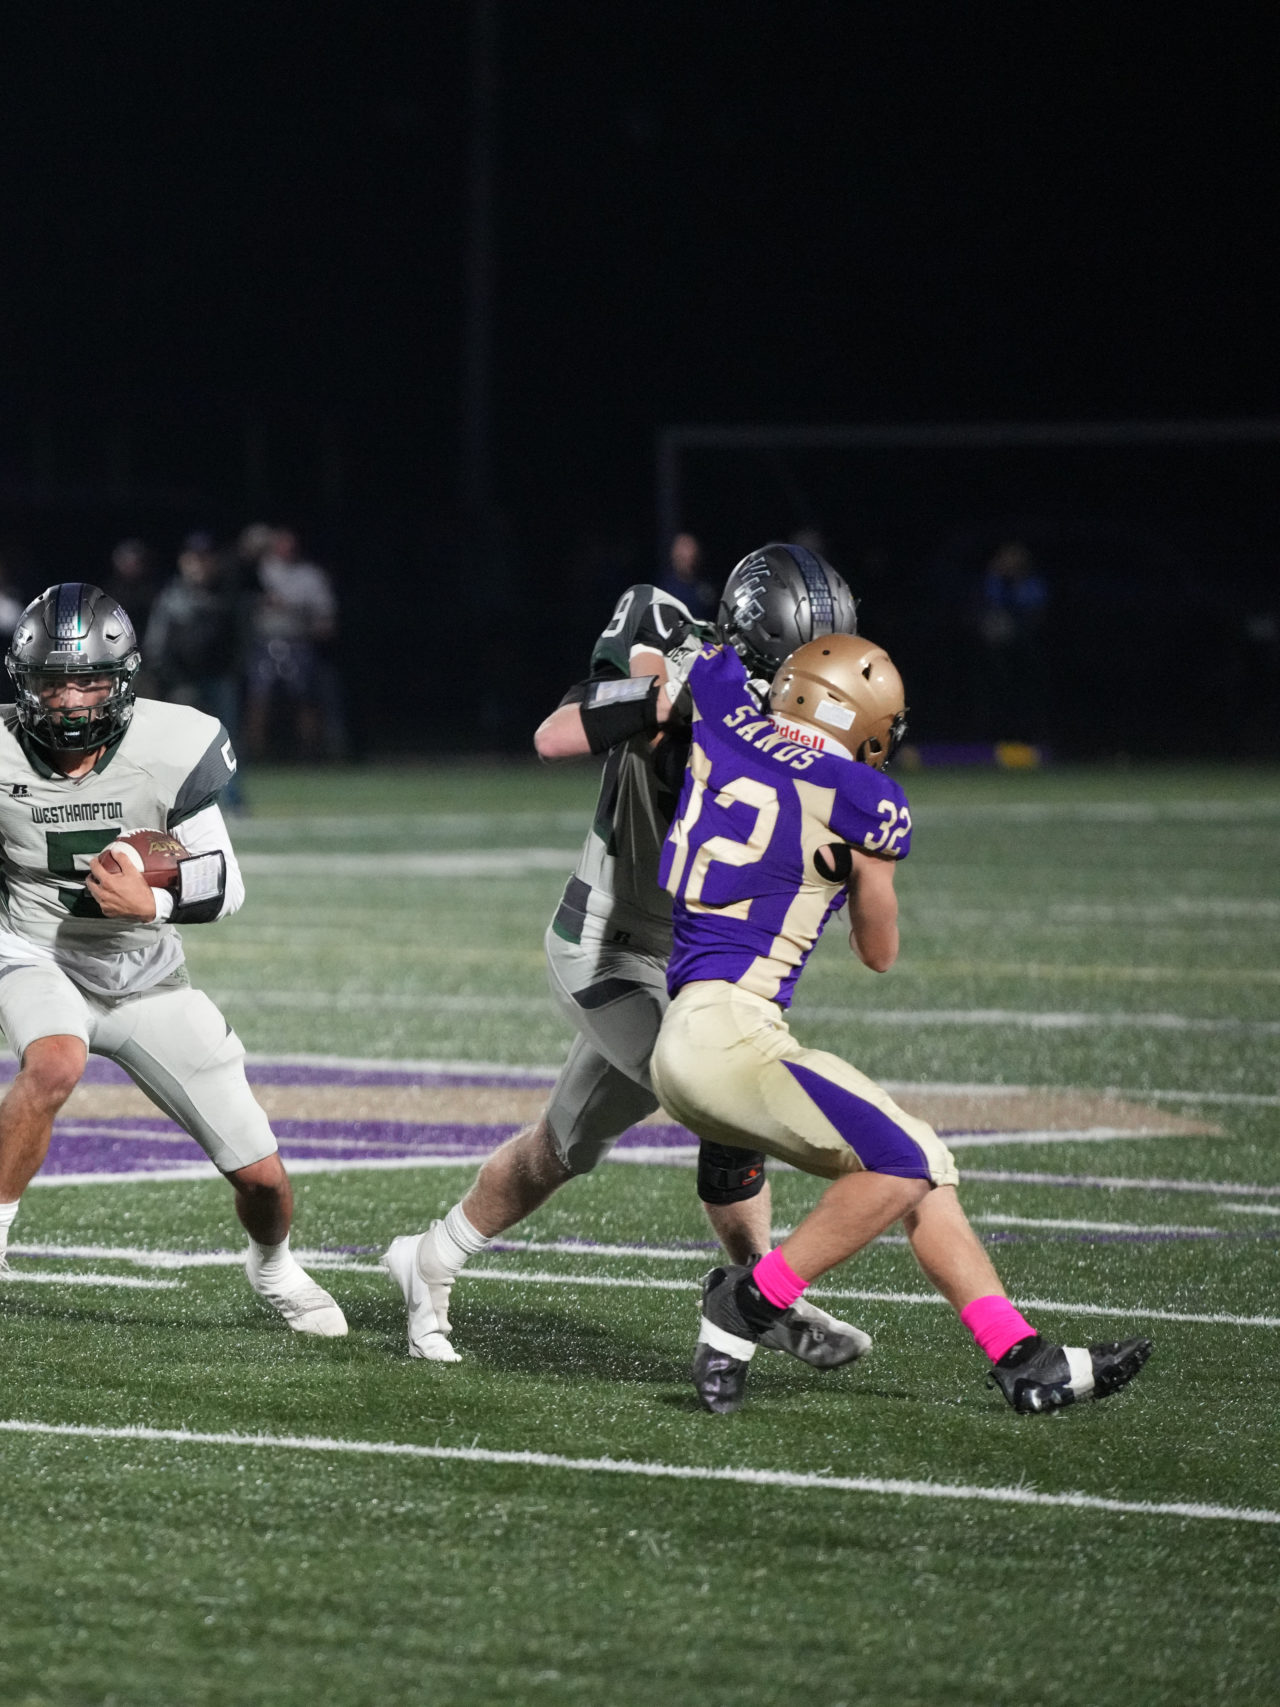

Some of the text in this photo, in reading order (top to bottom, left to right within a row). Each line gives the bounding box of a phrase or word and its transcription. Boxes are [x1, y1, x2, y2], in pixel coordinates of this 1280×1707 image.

[601, 590, 635, 638] 9
[723, 705, 825, 770] SANDS
[32, 802, 123, 824] WESTHAMPTON
[864, 799, 912, 856] 32
[45, 827, 121, 918] 5
